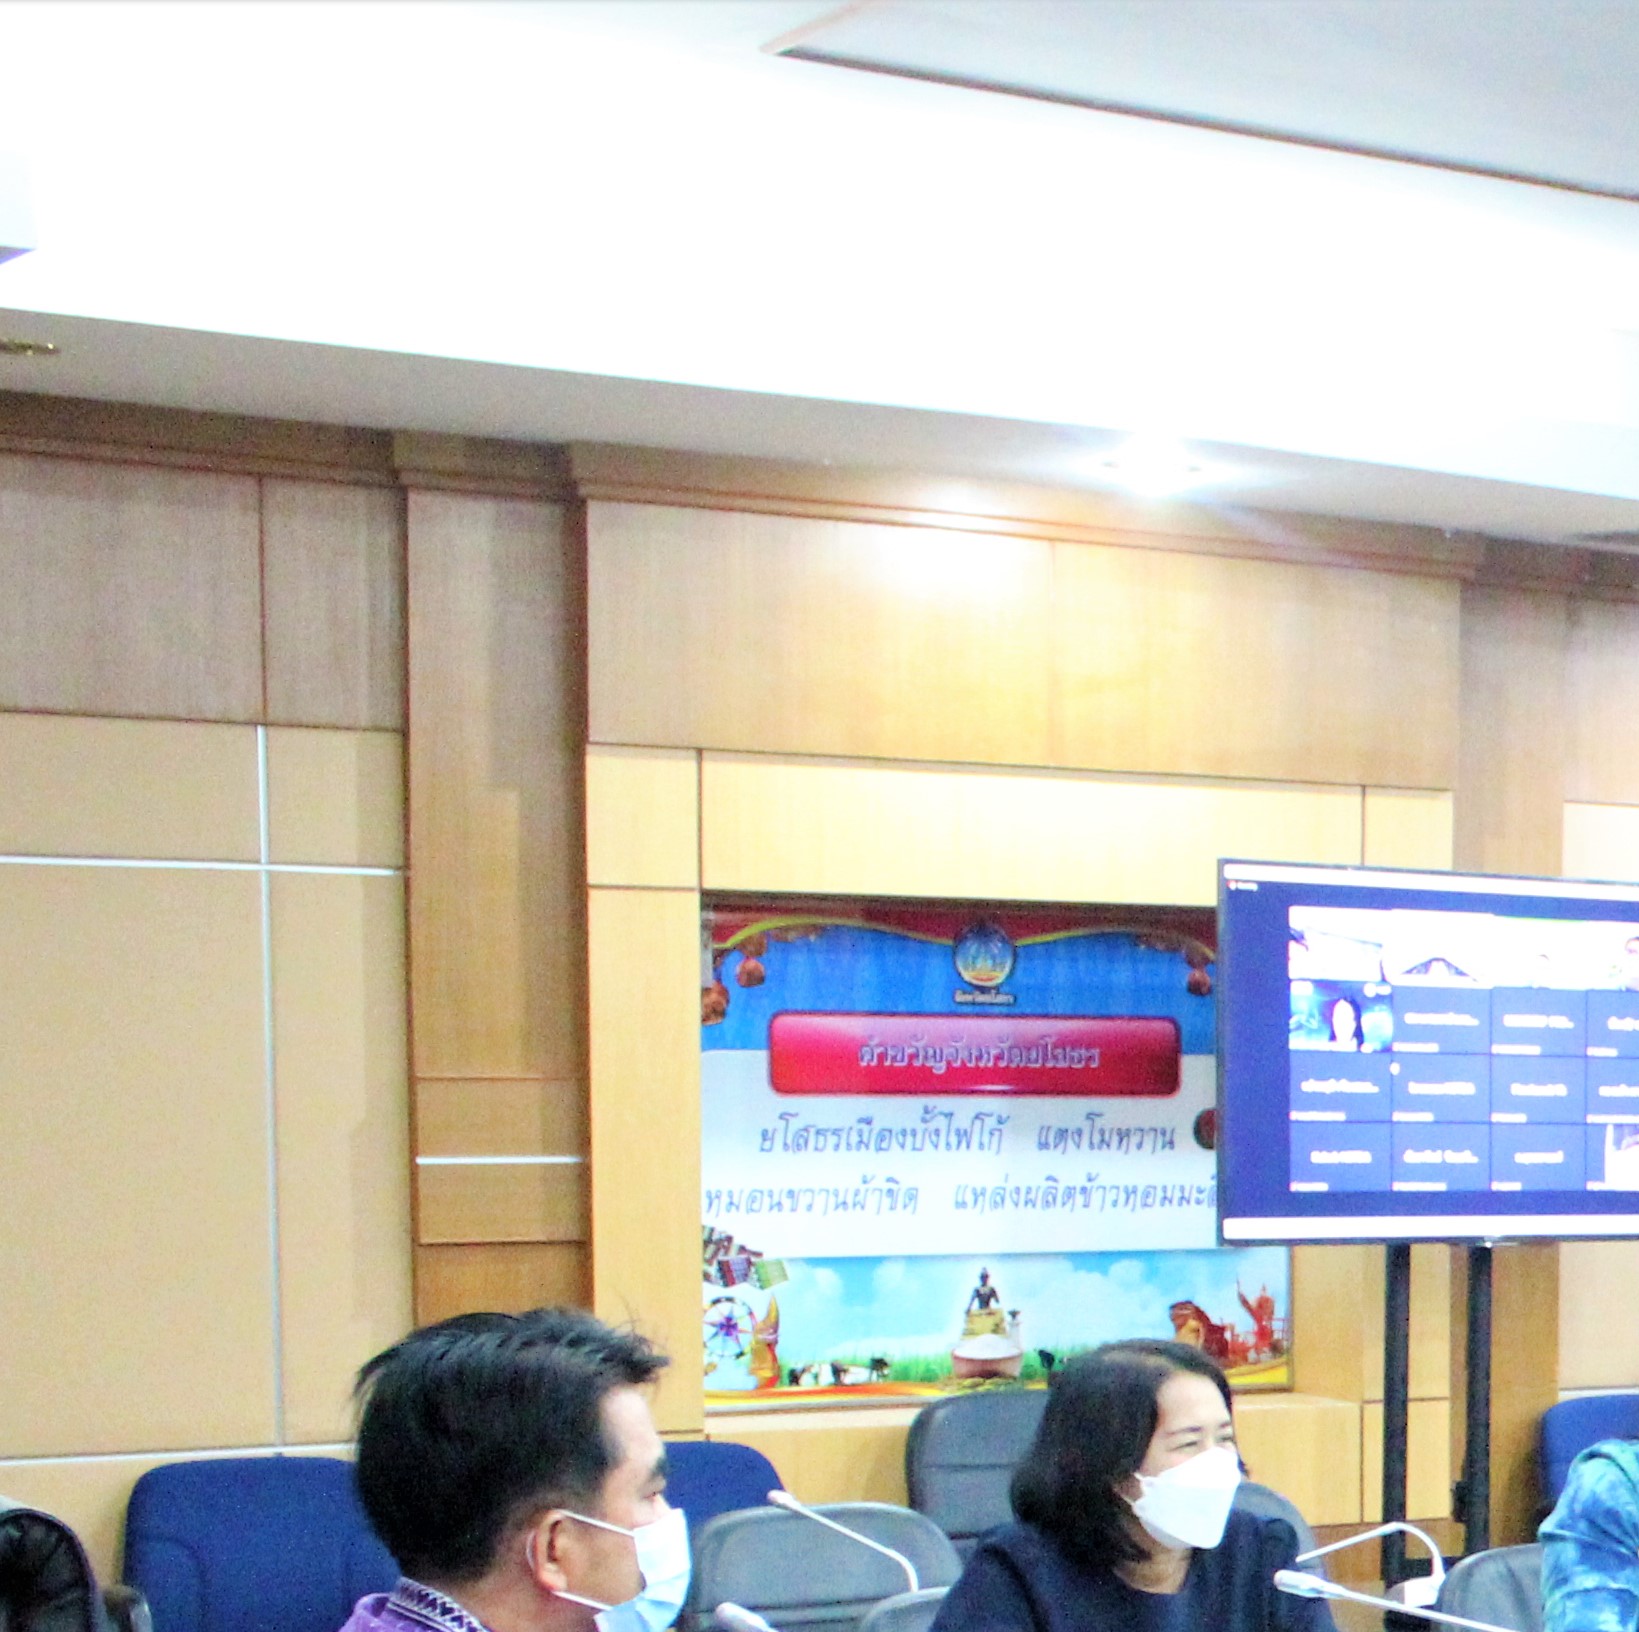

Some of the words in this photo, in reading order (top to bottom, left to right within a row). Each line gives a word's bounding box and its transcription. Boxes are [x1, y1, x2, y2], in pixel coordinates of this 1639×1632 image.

[858, 1032, 1101, 1075] คำขวัญจังหวัดยโสธร
[758, 1105, 1010, 1153] ยโสธรเมืองบั้งไฟโก้
[1036, 1111, 1176, 1153] แตงโมหวาน
[704, 1172, 919, 1218] หมอนขวานผ้าขิด
